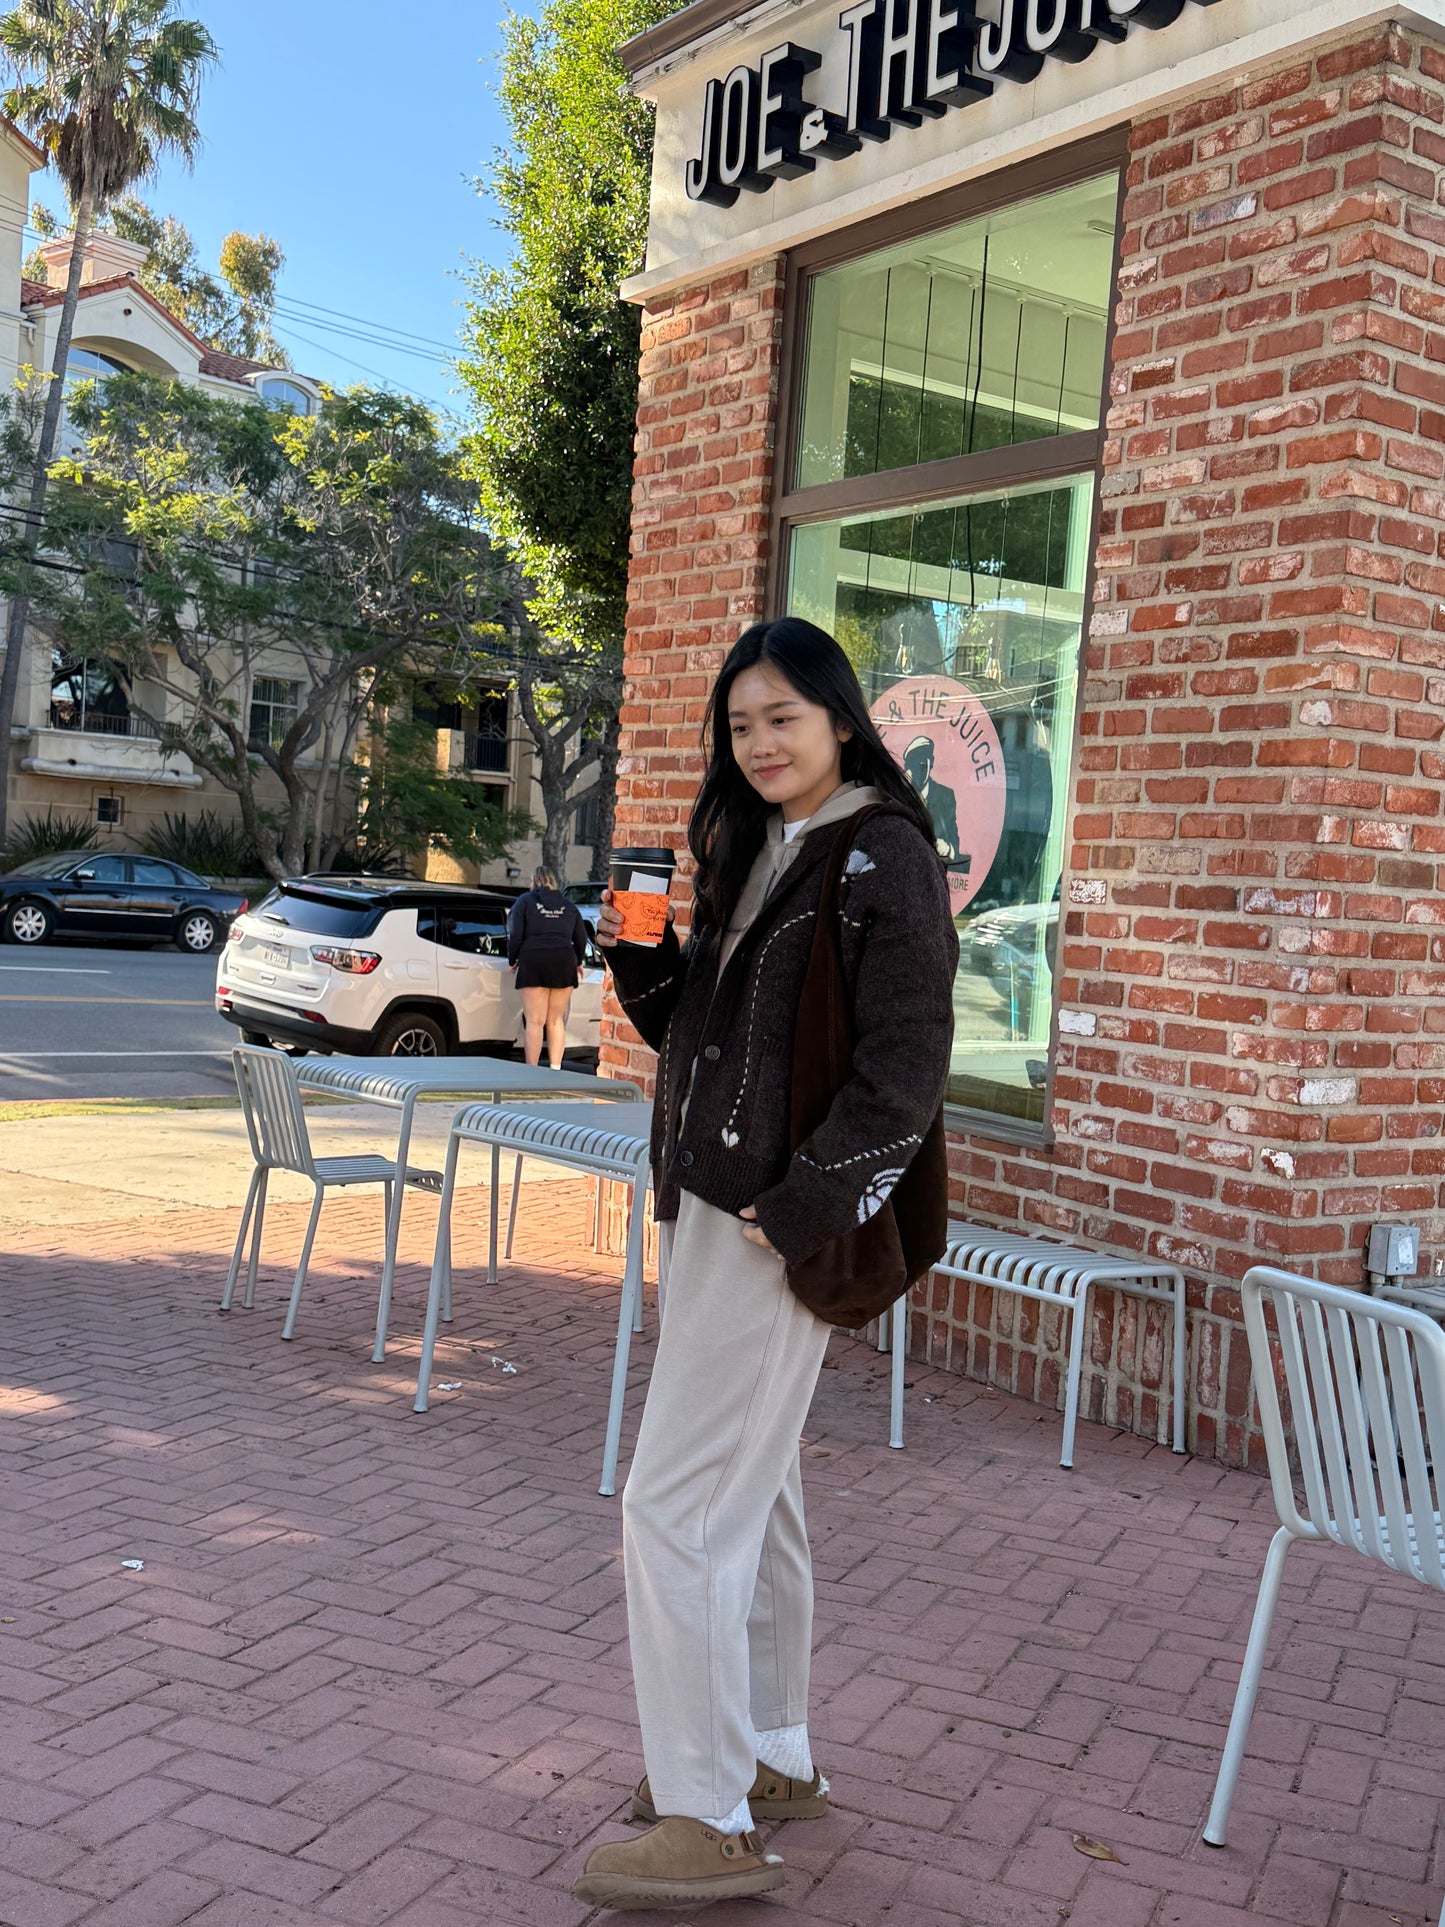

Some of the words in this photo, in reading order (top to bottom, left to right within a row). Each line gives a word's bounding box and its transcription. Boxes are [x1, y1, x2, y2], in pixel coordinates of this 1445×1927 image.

[686, 41, 790, 200] JOE
[840, 0, 960, 133] THE
[888, 700, 904, 722] &
[908, 688, 950, 720] THE
[949, 705, 996, 782] JUICE
